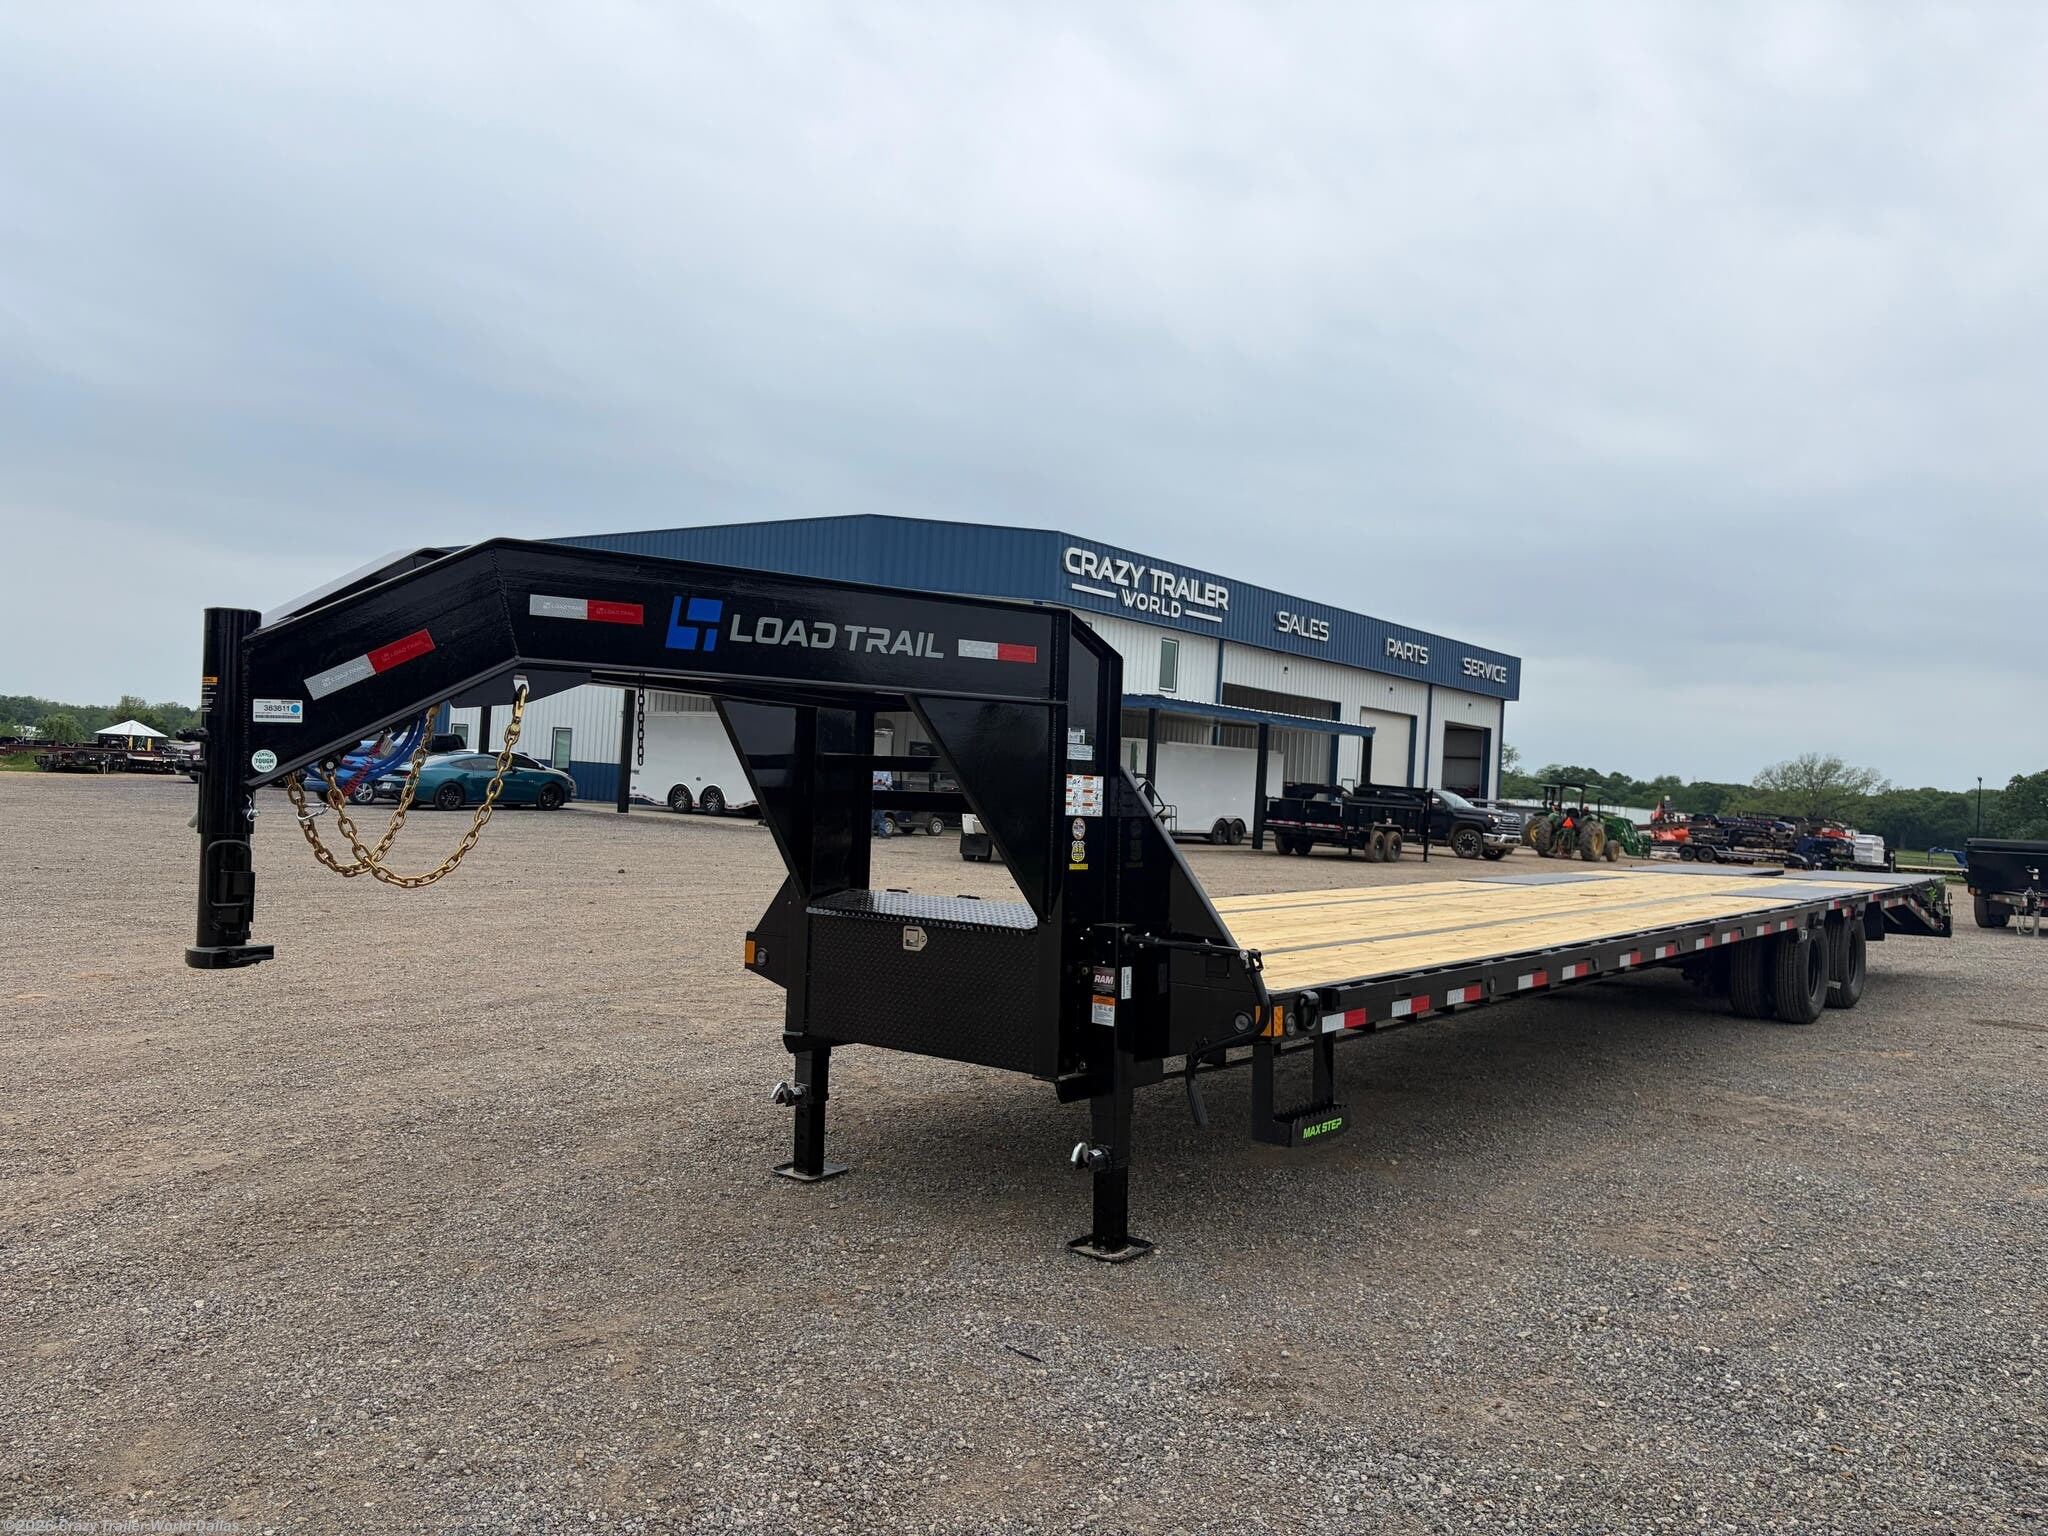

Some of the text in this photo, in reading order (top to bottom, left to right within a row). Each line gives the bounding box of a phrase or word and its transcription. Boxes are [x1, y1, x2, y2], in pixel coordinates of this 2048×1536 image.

[1064, 547, 1230, 611] CRAZY TRAILER
[1120, 588, 1182, 619] WORLD
[729, 614, 837, 649] LOAD
[844, 625, 945, 660] TRAIL
[1277, 611, 1330, 642] SALES
[1385, 638, 1429, 665] PARTS
[1463, 657, 1507, 683] SERVICE
[1094, 975, 1115, 985] RAM
[1302, 1117, 1342, 1139] MAX STEP
